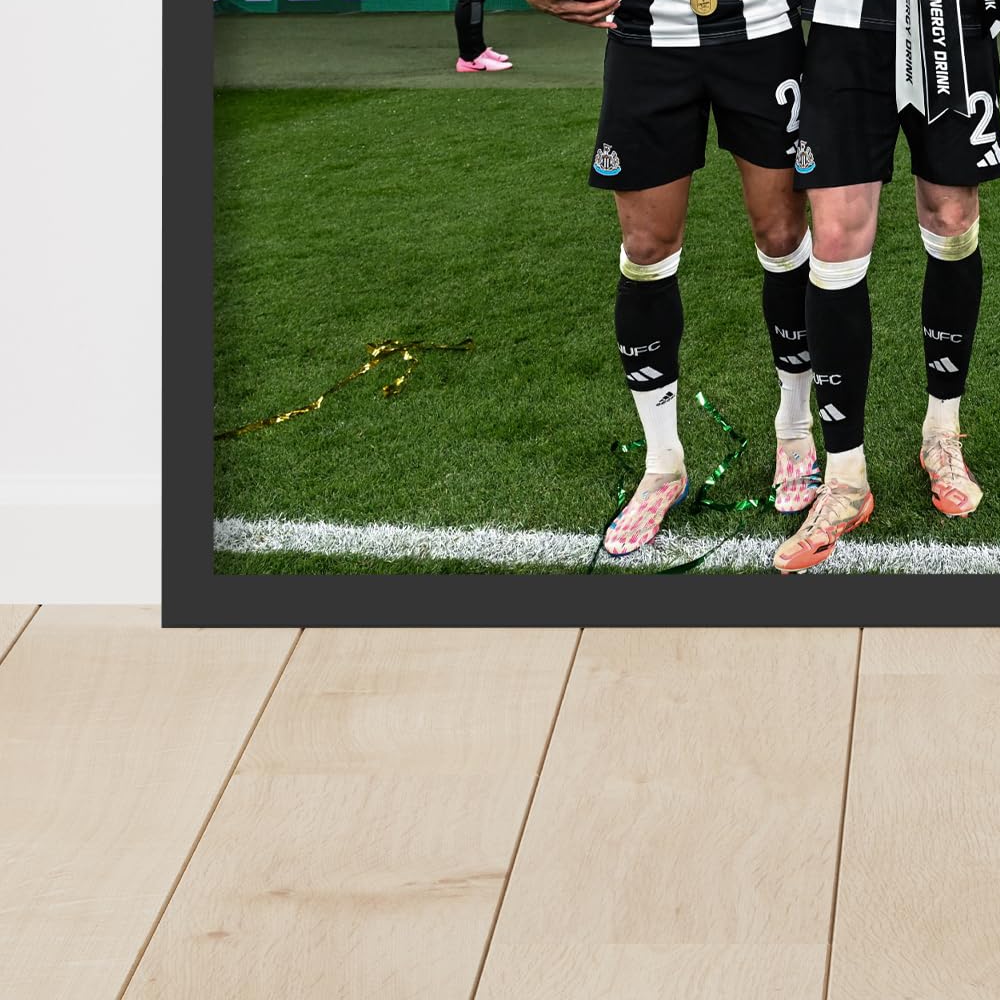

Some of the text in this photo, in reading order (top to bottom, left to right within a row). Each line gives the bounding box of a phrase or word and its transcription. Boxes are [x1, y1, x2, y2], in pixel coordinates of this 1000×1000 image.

[905, 38, 914, 87] DRINK
[933, 50, 951, 96] DRINK
[774, 324, 808, 341] NUF
[923, 325, 963, 344] NUFC
[812, 372, 842, 387] UFC
